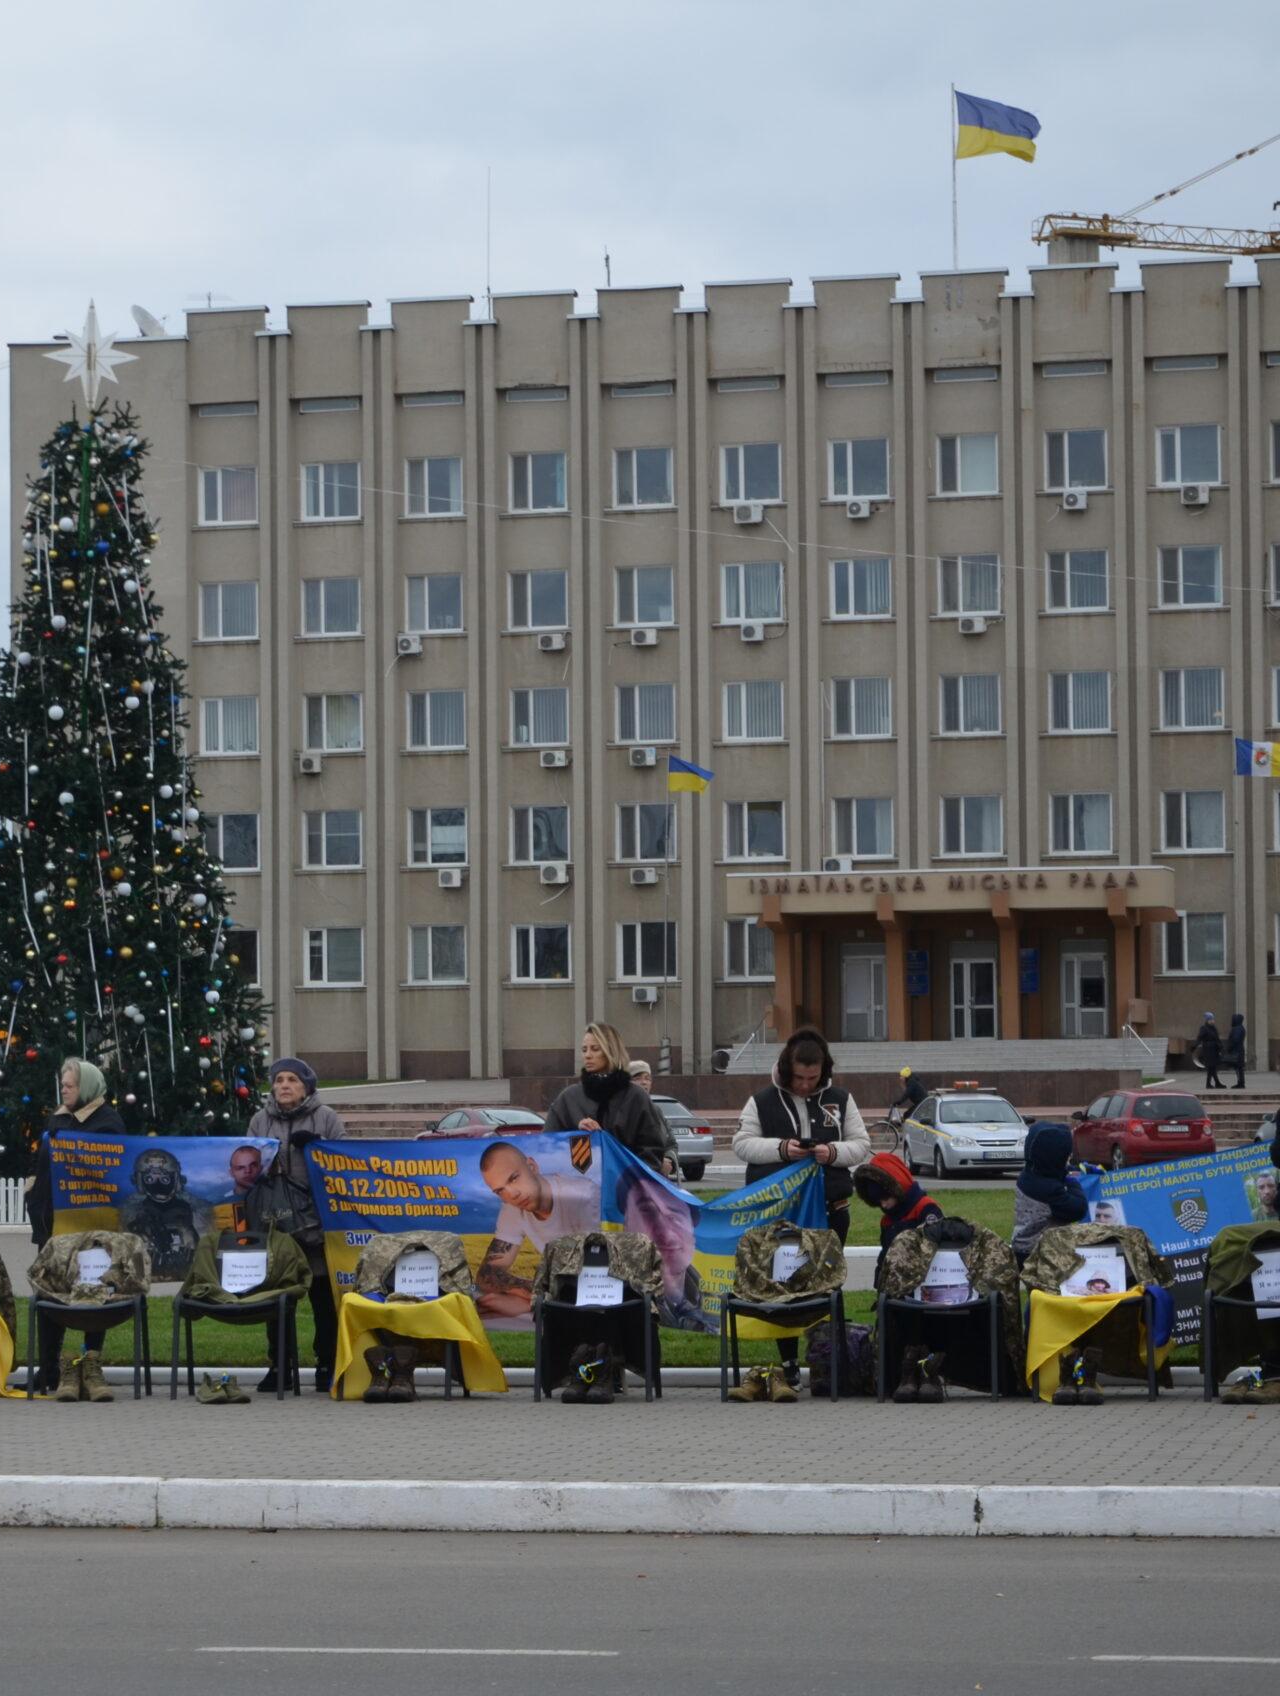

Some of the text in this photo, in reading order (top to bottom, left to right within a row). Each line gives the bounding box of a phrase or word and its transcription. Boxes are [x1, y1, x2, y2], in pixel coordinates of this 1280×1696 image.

[749, 871, 1140, 895] ІЗМАЇЛЬСЬКА МІСЬКА РАДА
[311, 1150, 458, 1178] Чуріш Радомир
[1101, 1184, 1129, 1198] НАШІ
[1130, 1178, 1162, 1194] ГЕРОЇ
[1163, 1172, 1203, 1188] МАЮТЬ
[1205, 1163, 1233, 1179] БУТИ
[1111, 1166, 1162, 1184] БРИГАДА
[324, 1176, 456, 1200] 30.12.2005 р.н.
[328, 1199, 460, 1218] 3 штурмова бригада
[346, 1232, 374, 1246] Зни
[1160, 1235, 1217, 1254] Наші хло
[1173, 1256, 1200, 1269] Наш
[1177, 1308, 1194, 1320] МИ
